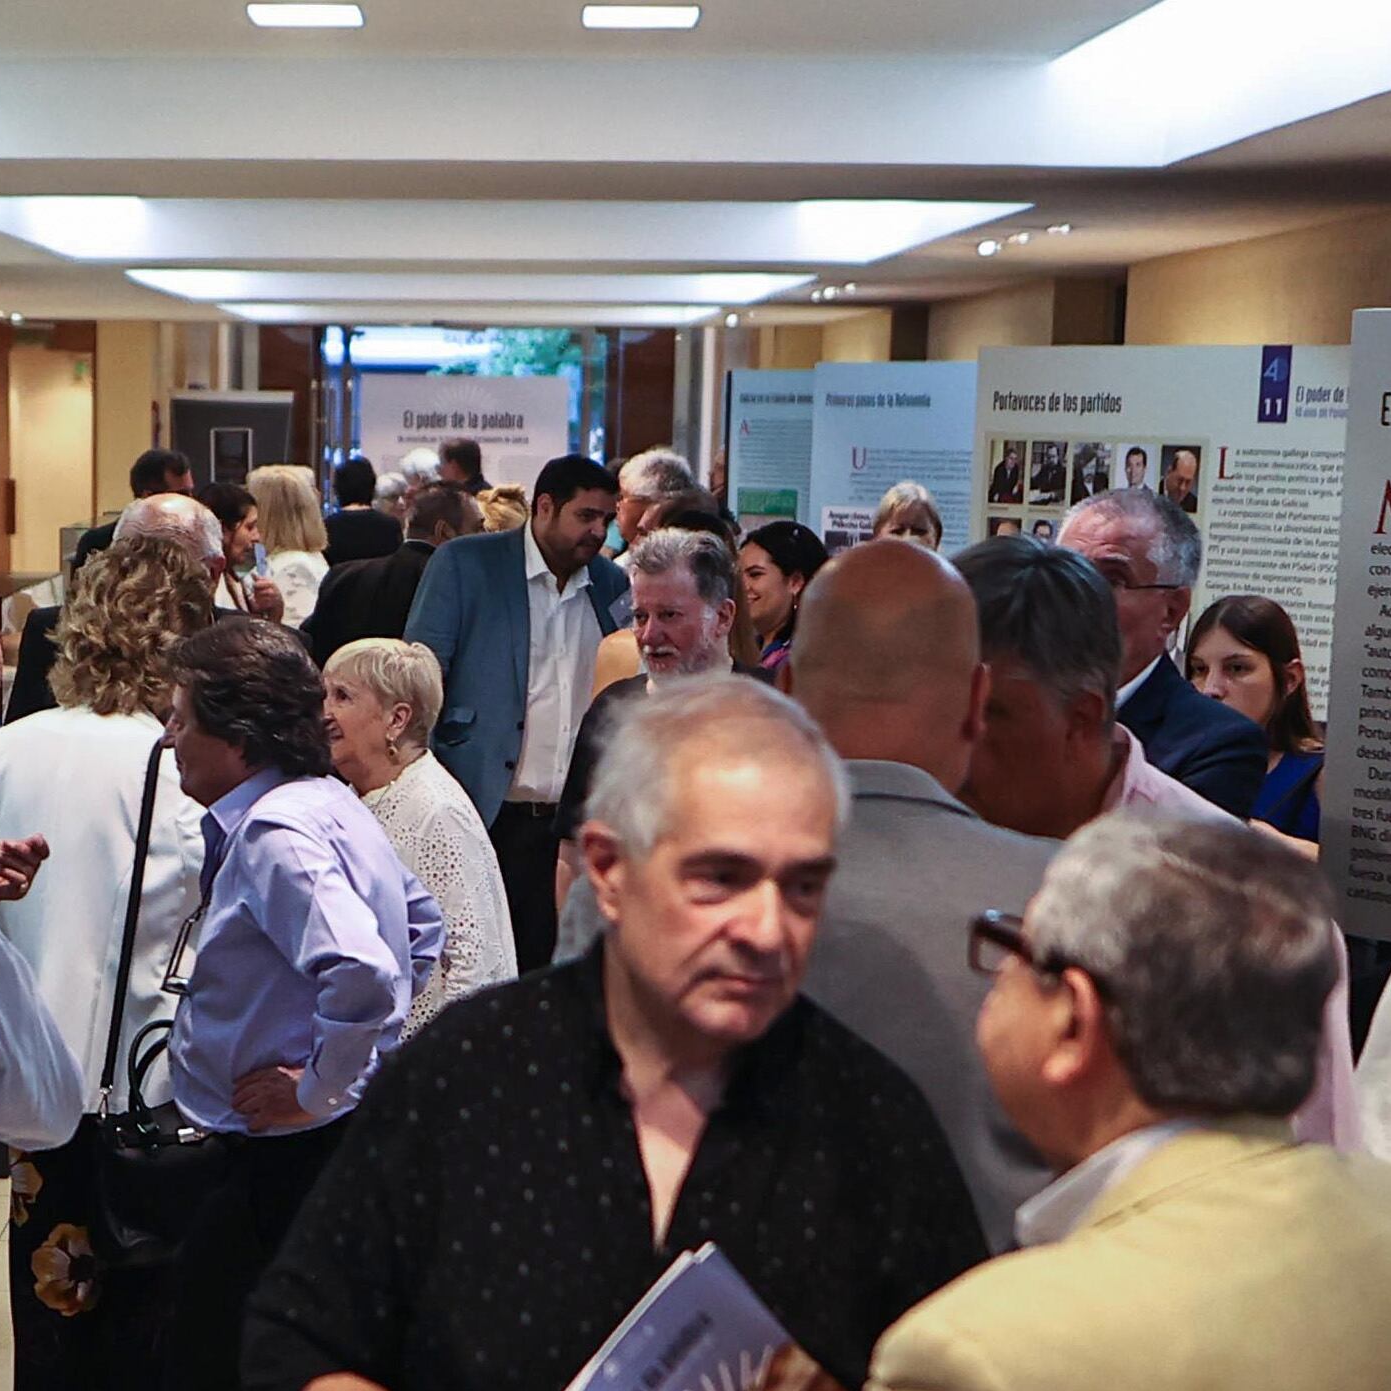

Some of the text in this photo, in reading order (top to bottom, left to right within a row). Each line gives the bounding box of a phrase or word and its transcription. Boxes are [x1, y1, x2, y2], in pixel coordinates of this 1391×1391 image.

[993, 391, 1122, 416] Portavoces de los partidos
[1306, 386, 1331, 404] poder
[1333, 386, 1344, 402] de
[1264, 398, 1282, 415] 11
[403, 409, 524, 430] El poder de la palabra
[1369, 565, 1390, 577] con
[1357, 744, 1391, 762] desde
[1351, 824, 1376, 842] BNG
